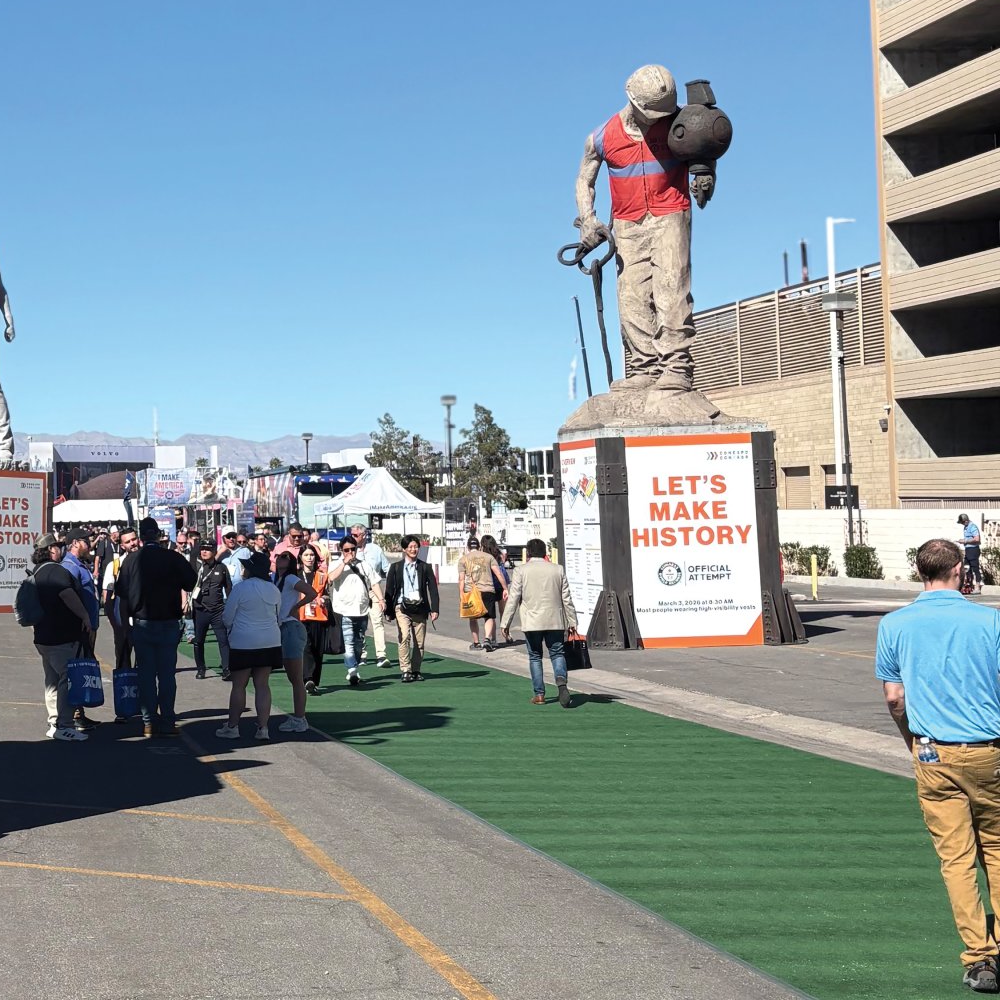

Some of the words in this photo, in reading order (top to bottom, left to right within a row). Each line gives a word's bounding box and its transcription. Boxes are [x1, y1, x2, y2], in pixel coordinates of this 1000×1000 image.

[652, 475, 727, 496] LET’S
[649, 501, 728, 521] MAKE
[632, 525, 752, 547] HISTORY
[688, 565, 731, 573] OFFICIAL
[688, 573, 731, 581] ATTEMPT
